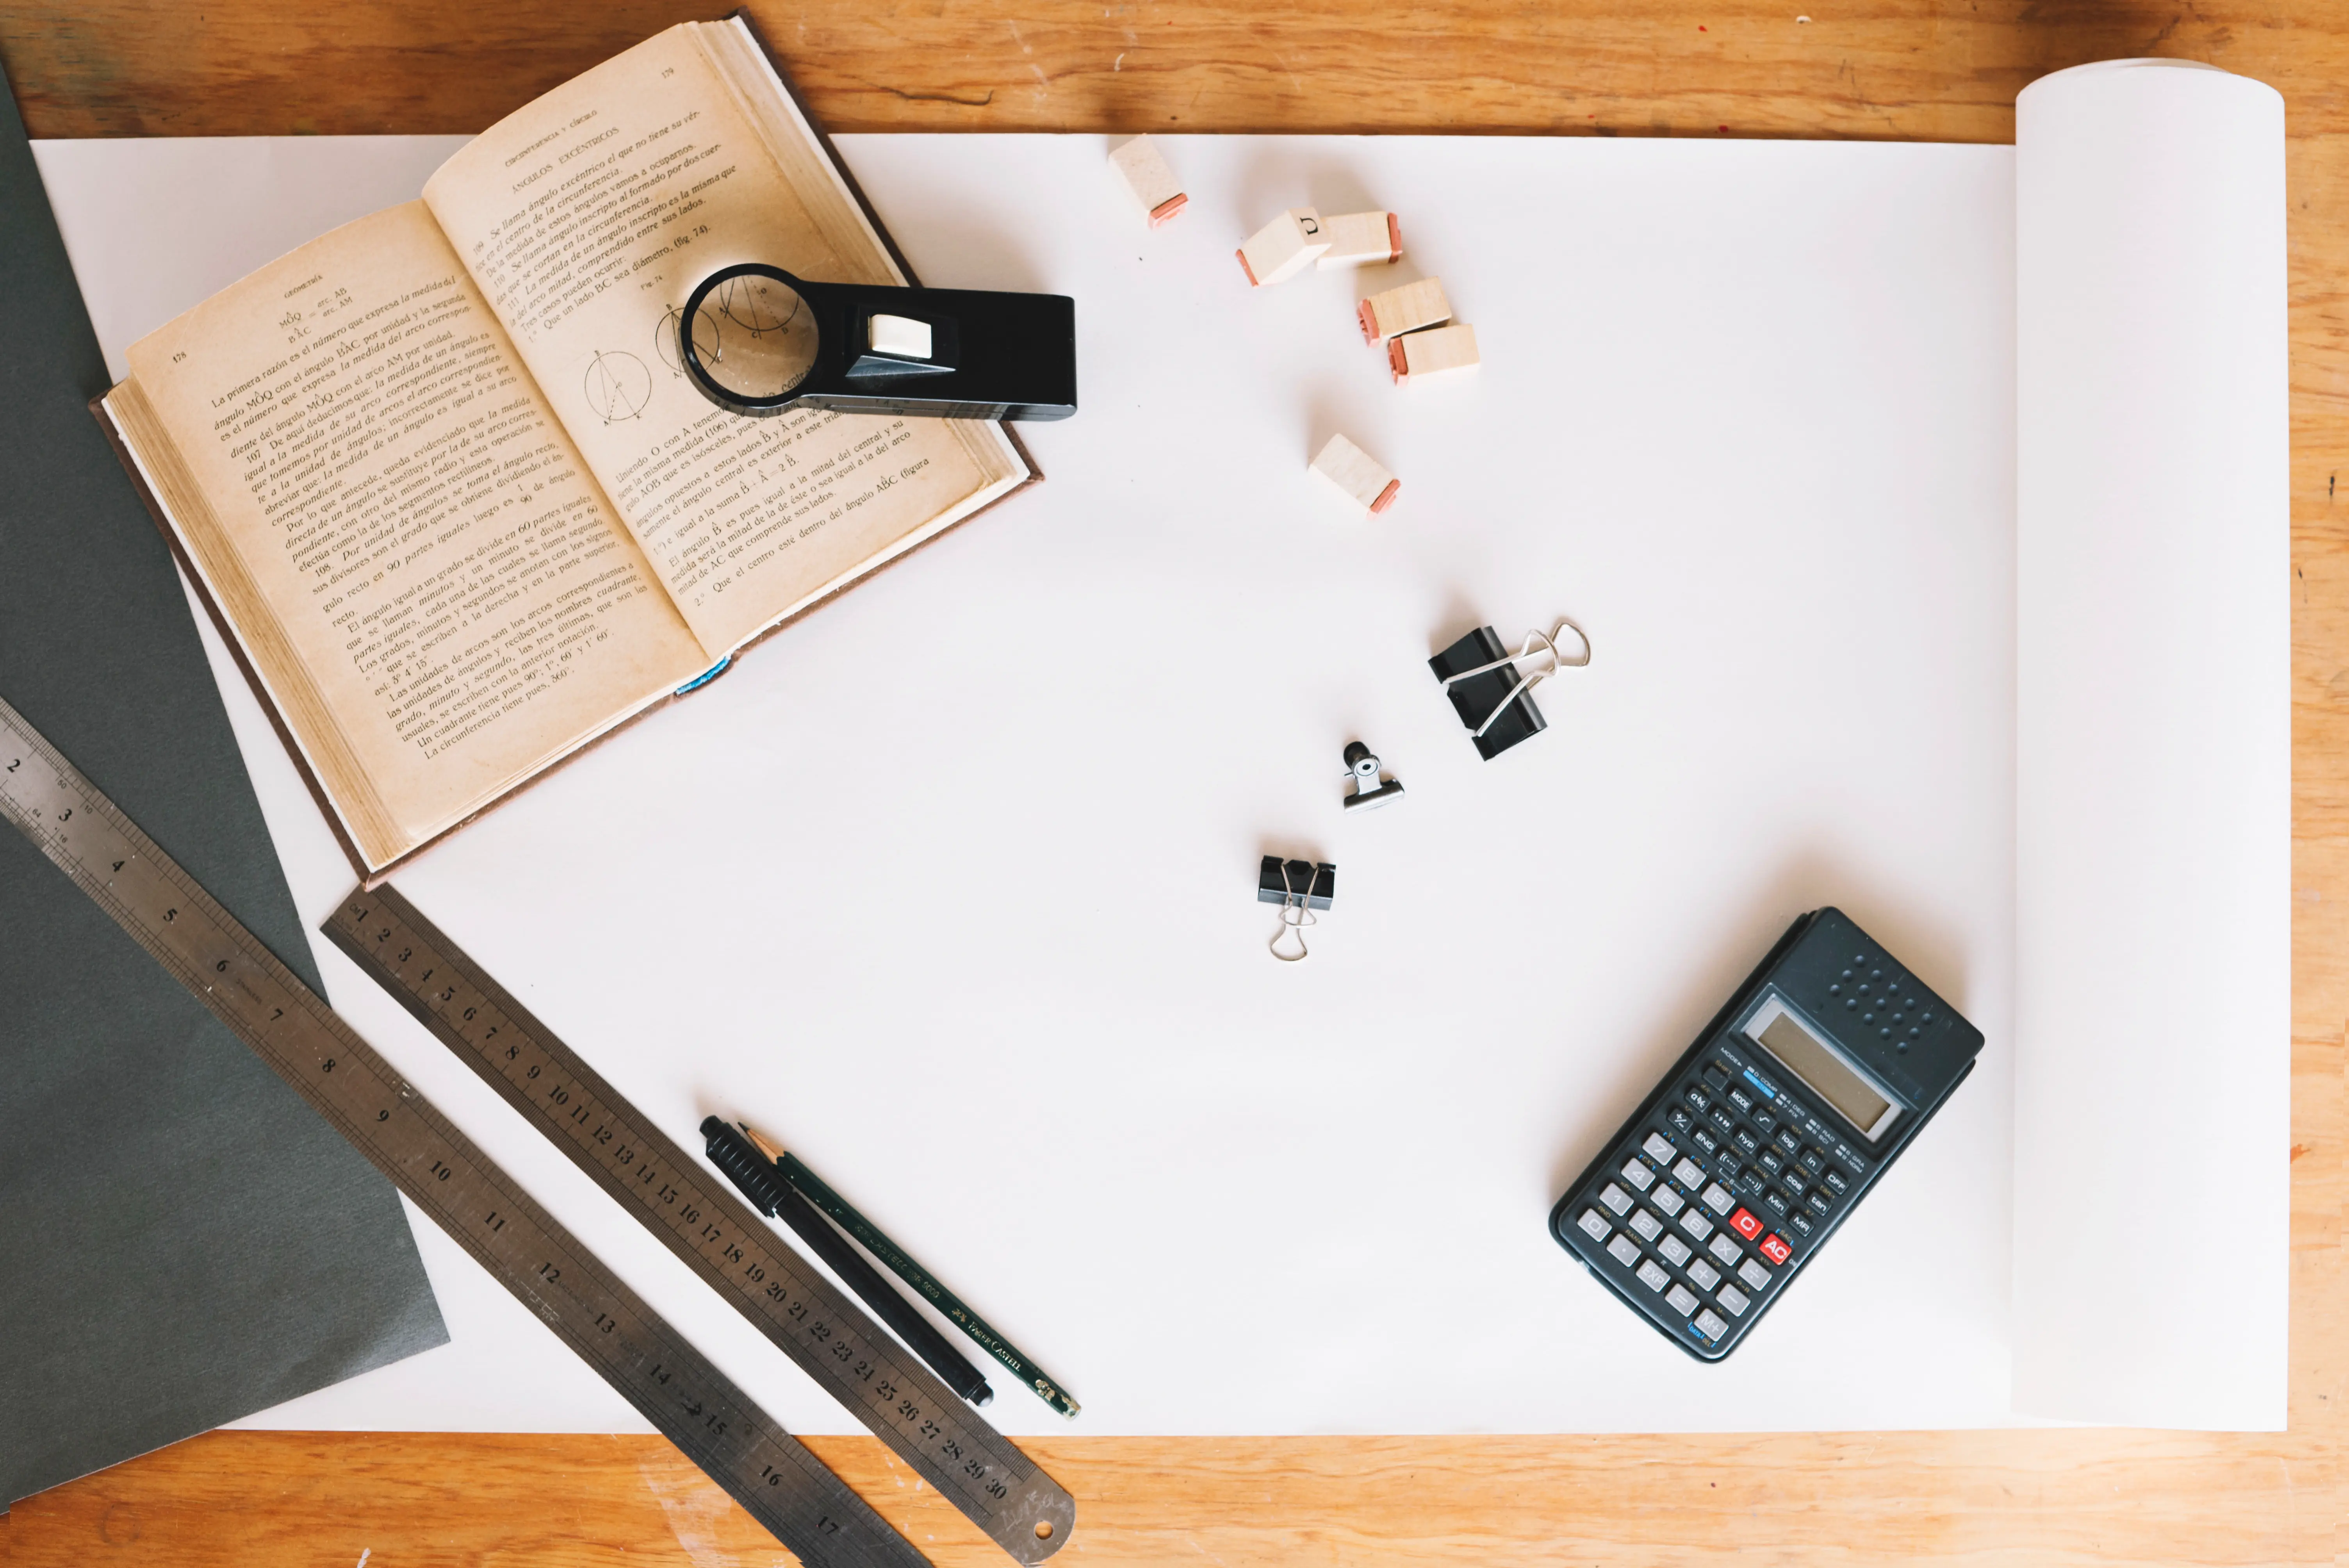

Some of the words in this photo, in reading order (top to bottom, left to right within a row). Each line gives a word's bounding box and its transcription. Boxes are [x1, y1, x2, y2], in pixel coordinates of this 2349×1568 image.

[661, 67, 674, 79] 179
[512, 164, 553, 194] ÁNGULOS
[558, 127, 620, 164] EXCÉNTRICOS
[490, 228, 501, 240] Se
[502, 209, 526, 230] llama
[528, 189, 558, 212] ángulo
[560, 161, 606, 191] excéntrico
[607, 153, 616, 164] el
[618, 145, 633, 159] que
[635, 139, 647, 149] no
[648, 127, 669, 142] tiene
[671, 120, 682, 130] su
[544, 314, 561, 330] Que
[562, 305, 574, 315] un
[574, 292, 594, 307] lado
[594, 278, 612, 294] BC
[614, 269, 630, 282] sea
[632, 246, 674, 271] diámetro,
[674, 235, 693, 248] (fig.
[692, 225, 711, 237] 74).
[173, 351, 187, 363] 178
[231, 438, 257, 459] diente
[260, 427, 274, 441] del
[276, 410, 306, 432] ángulo
[335, 383, 353, 396] con
[354, 375, 363, 385] el
[365, 365, 385, 380] arco
[387, 353, 403, 368] AM
[405, 346, 420, 360] por
[299, 550, 330, 572] efectúa
[331, 535, 356, 552] como
[357, 527, 368, 536] la
[369, 520, 380, 529] de
[381, 510, 397, 522] los
[398, 482, 446, 512] segmentos
[713, 577, 732, 593] Que
[736, 567, 745, 577] el
[747, 550, 775, 570] centro
[778, 537, 796, 551] esté
[799, 519, 826, 538] dentro
[829, 507, 843, 520] del
[845, 491, 874, 511] ángulo
[900, 458, 930, 479] (figura
[424, 748, 439, 760] La
[440, 710, 501, 750] circunferencia
[502, 697, 524, 713] tiene
[525, 683, 550, 701] pues,
[1731, 1091, 1750, 1109] MODE
[7, 758, 21, 773] 2
[58, 809, 72, 821] 3
[112, 861, 125, 873] 4
[163, 909, 178, 921] 5
[216, 960, 230, 972] 6
[270, 1008, 283, 1021] 7
[322, 1059, 336, 1073] 8
[377, 1110, 389, 1122] 9
[430, 1161, 451, 1181] 10
[485, 1212, 505, 1232] 11
[539, 1262, 560, 1284] 12
[595, 1313, 615, 1333] 13
[650, 1364, 672, 1385] 14
[706, 1414, 727, 1435] 15
[761, 1465, 783, 1486] 16
[818, 1516, 839, 1535] 17
[1654, 1141, 1668, 1153] 7
[1695, 1132, 1715, 1150] ENG
[1738, 1132, 1754, 1148] hyp
[1781, 1134, 1795, 1149] log
[1764, 1156, 1777, 1169] sin
[1632, 1171, 1645, 1181] 4
[1682, 1167, 1696, 1181] 8
[1828, 1174, 1846, 1189] OFF
[1786, 1175, 1803, 1190] cos
[357, 909, 369, 922] 1
[378, 928, 391, 942] 2
[398, 948, 412, 962] 3
[422, 969, 433, 982] 4
[441, 986, 456, 1001] 5
[463, 1007, 477, 1021] 6
[486, 1026, 497, 1040] 7
[505, 1046, 520, 1060] 8
[527, 1066, 541, 1079] 9
[549, 1085, 569, 1105] 10
[570, 1105, 590, 1125] 11
[592, 1125, 612, 1145] 12
[614, 1144, 634, 1165] 13
[636, 1164, 656, 1185] 14
[658, 1184, 679, 1204] 15
[679, 1203, 700, 1224] 16
[701, 1223, 721, 1242] 17
[723, 1243, 743, 1263] 18
[745, 1263, 765, 1283] 19
[766, 1282, 787, 1303] 20
[788, 1302, 808, 1323] 21
[809, 1322, 831, 1342] 22
[832, 1341, 853, 1362] 23
[854, 1361, 875, 1382] 24
[875, 1380, 898, 1401] 25
[898, 1400, 920, 1421] 26
[920, 1420, 941, 1440] 27
[942, 1440, 963, 1460] 28
[964, 1459, 985, 1479] 29
[985, 1479, 1007, 1499] 30
[1613, 1195, 1622, 1205] 1
[1660, 1192, 1675, 1206] 5
[1711, 1192, 1725, 1206] 9
[1768, 1195, 1784, 1211] Min
[1811, 1196, 1827, 1212] tan
[1588, 1218, 1602, 1233] 0
[1638, 1218, 1653, 1233] 2
[1689, 1217, 1703, 1231] 6
[1740, 1216, 1755, 1231] C
[1794, 1216, 1810, 1232] MR
[1667, 1243, 1681, 1257] 3
[1765, 1241, 1788, 1262] AC
[1641, 1265, 1665, 1283] EXP
[1700, 1315, 1719, 1332] M+
